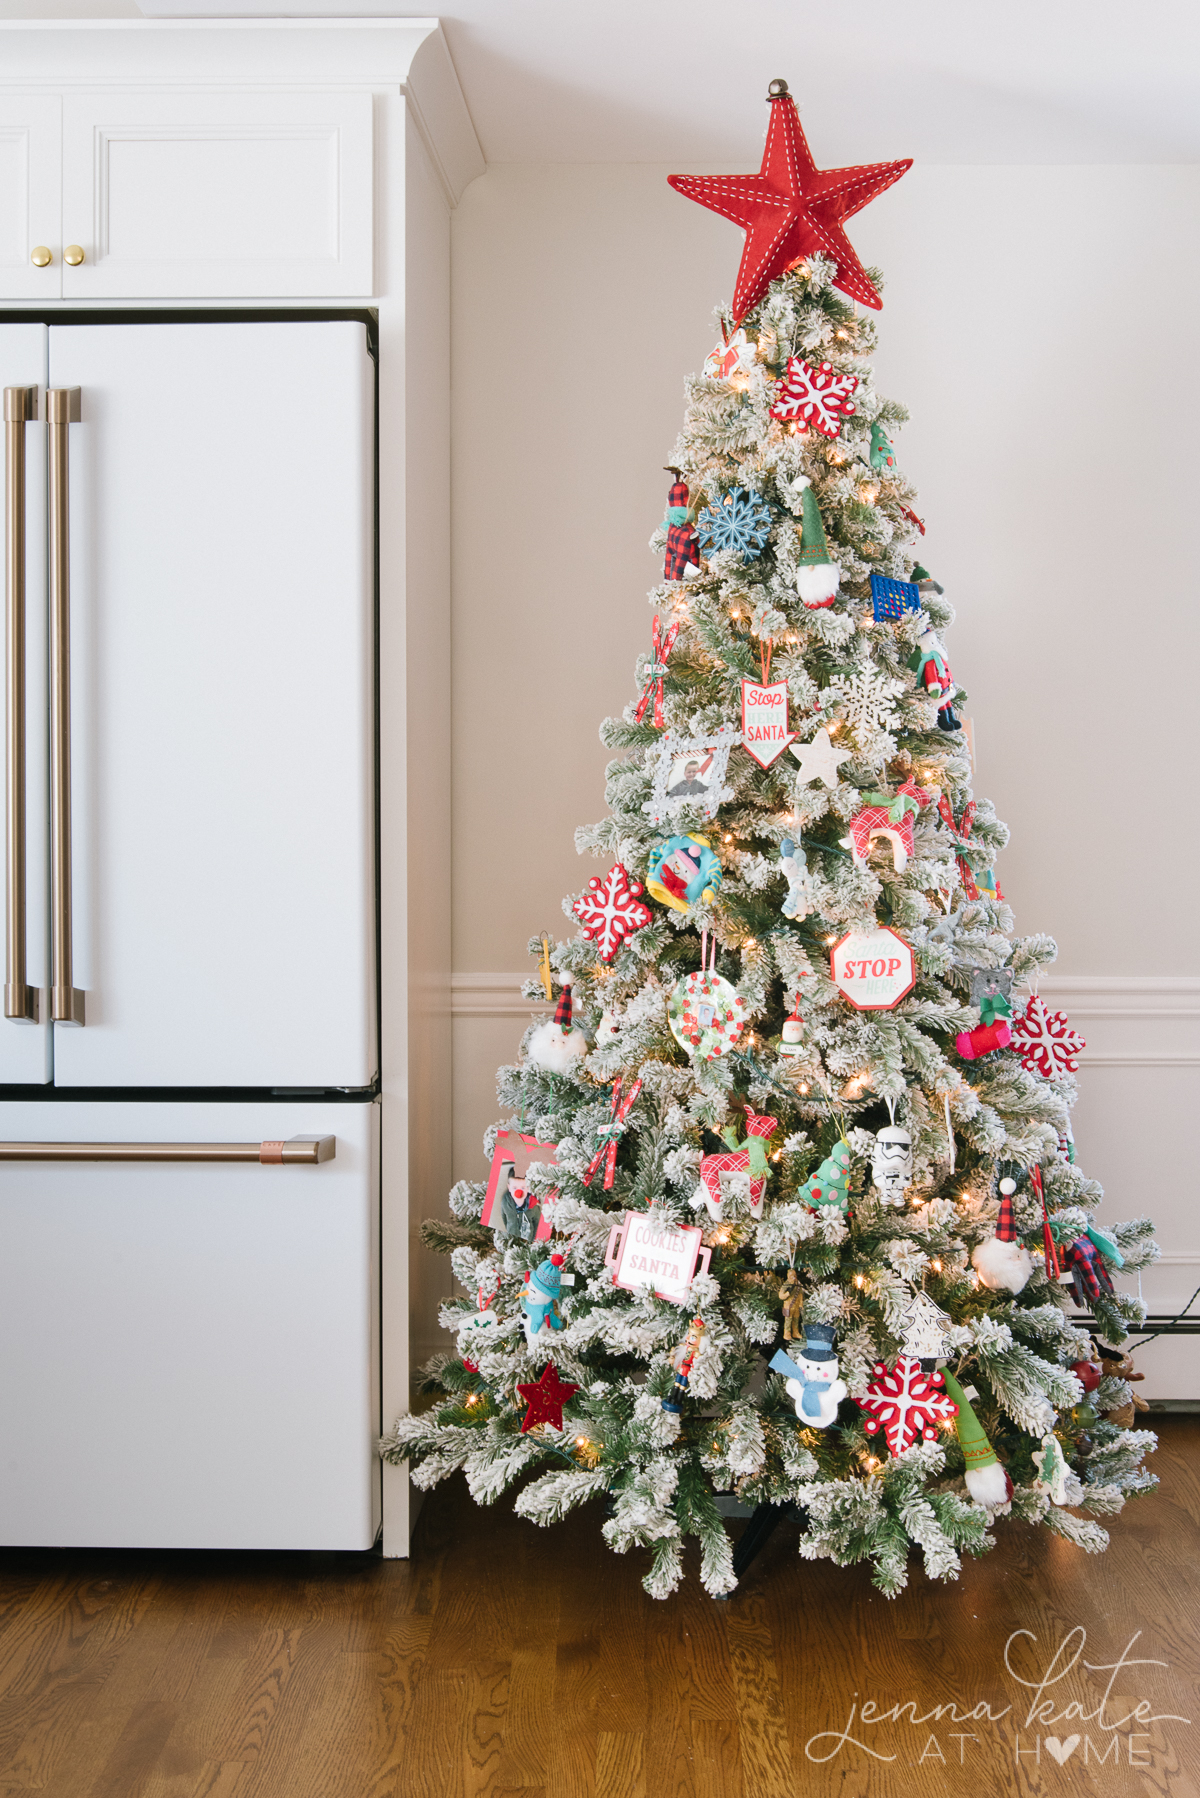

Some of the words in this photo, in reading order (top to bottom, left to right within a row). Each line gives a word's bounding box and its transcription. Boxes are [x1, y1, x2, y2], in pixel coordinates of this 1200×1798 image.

[747, 690, 784, 709] Stop
[747, 712, 784, 724] HERE
[747, 725, 786, 741] SANTA
[843, 941, 897, 959] Santa
[843, 958, 902, 979] STOP
[866, 979, 896, 995] HERE
[635, 1226, 687, 1253] COOKIES
[629, 1254, 680, 1280] SANTA
